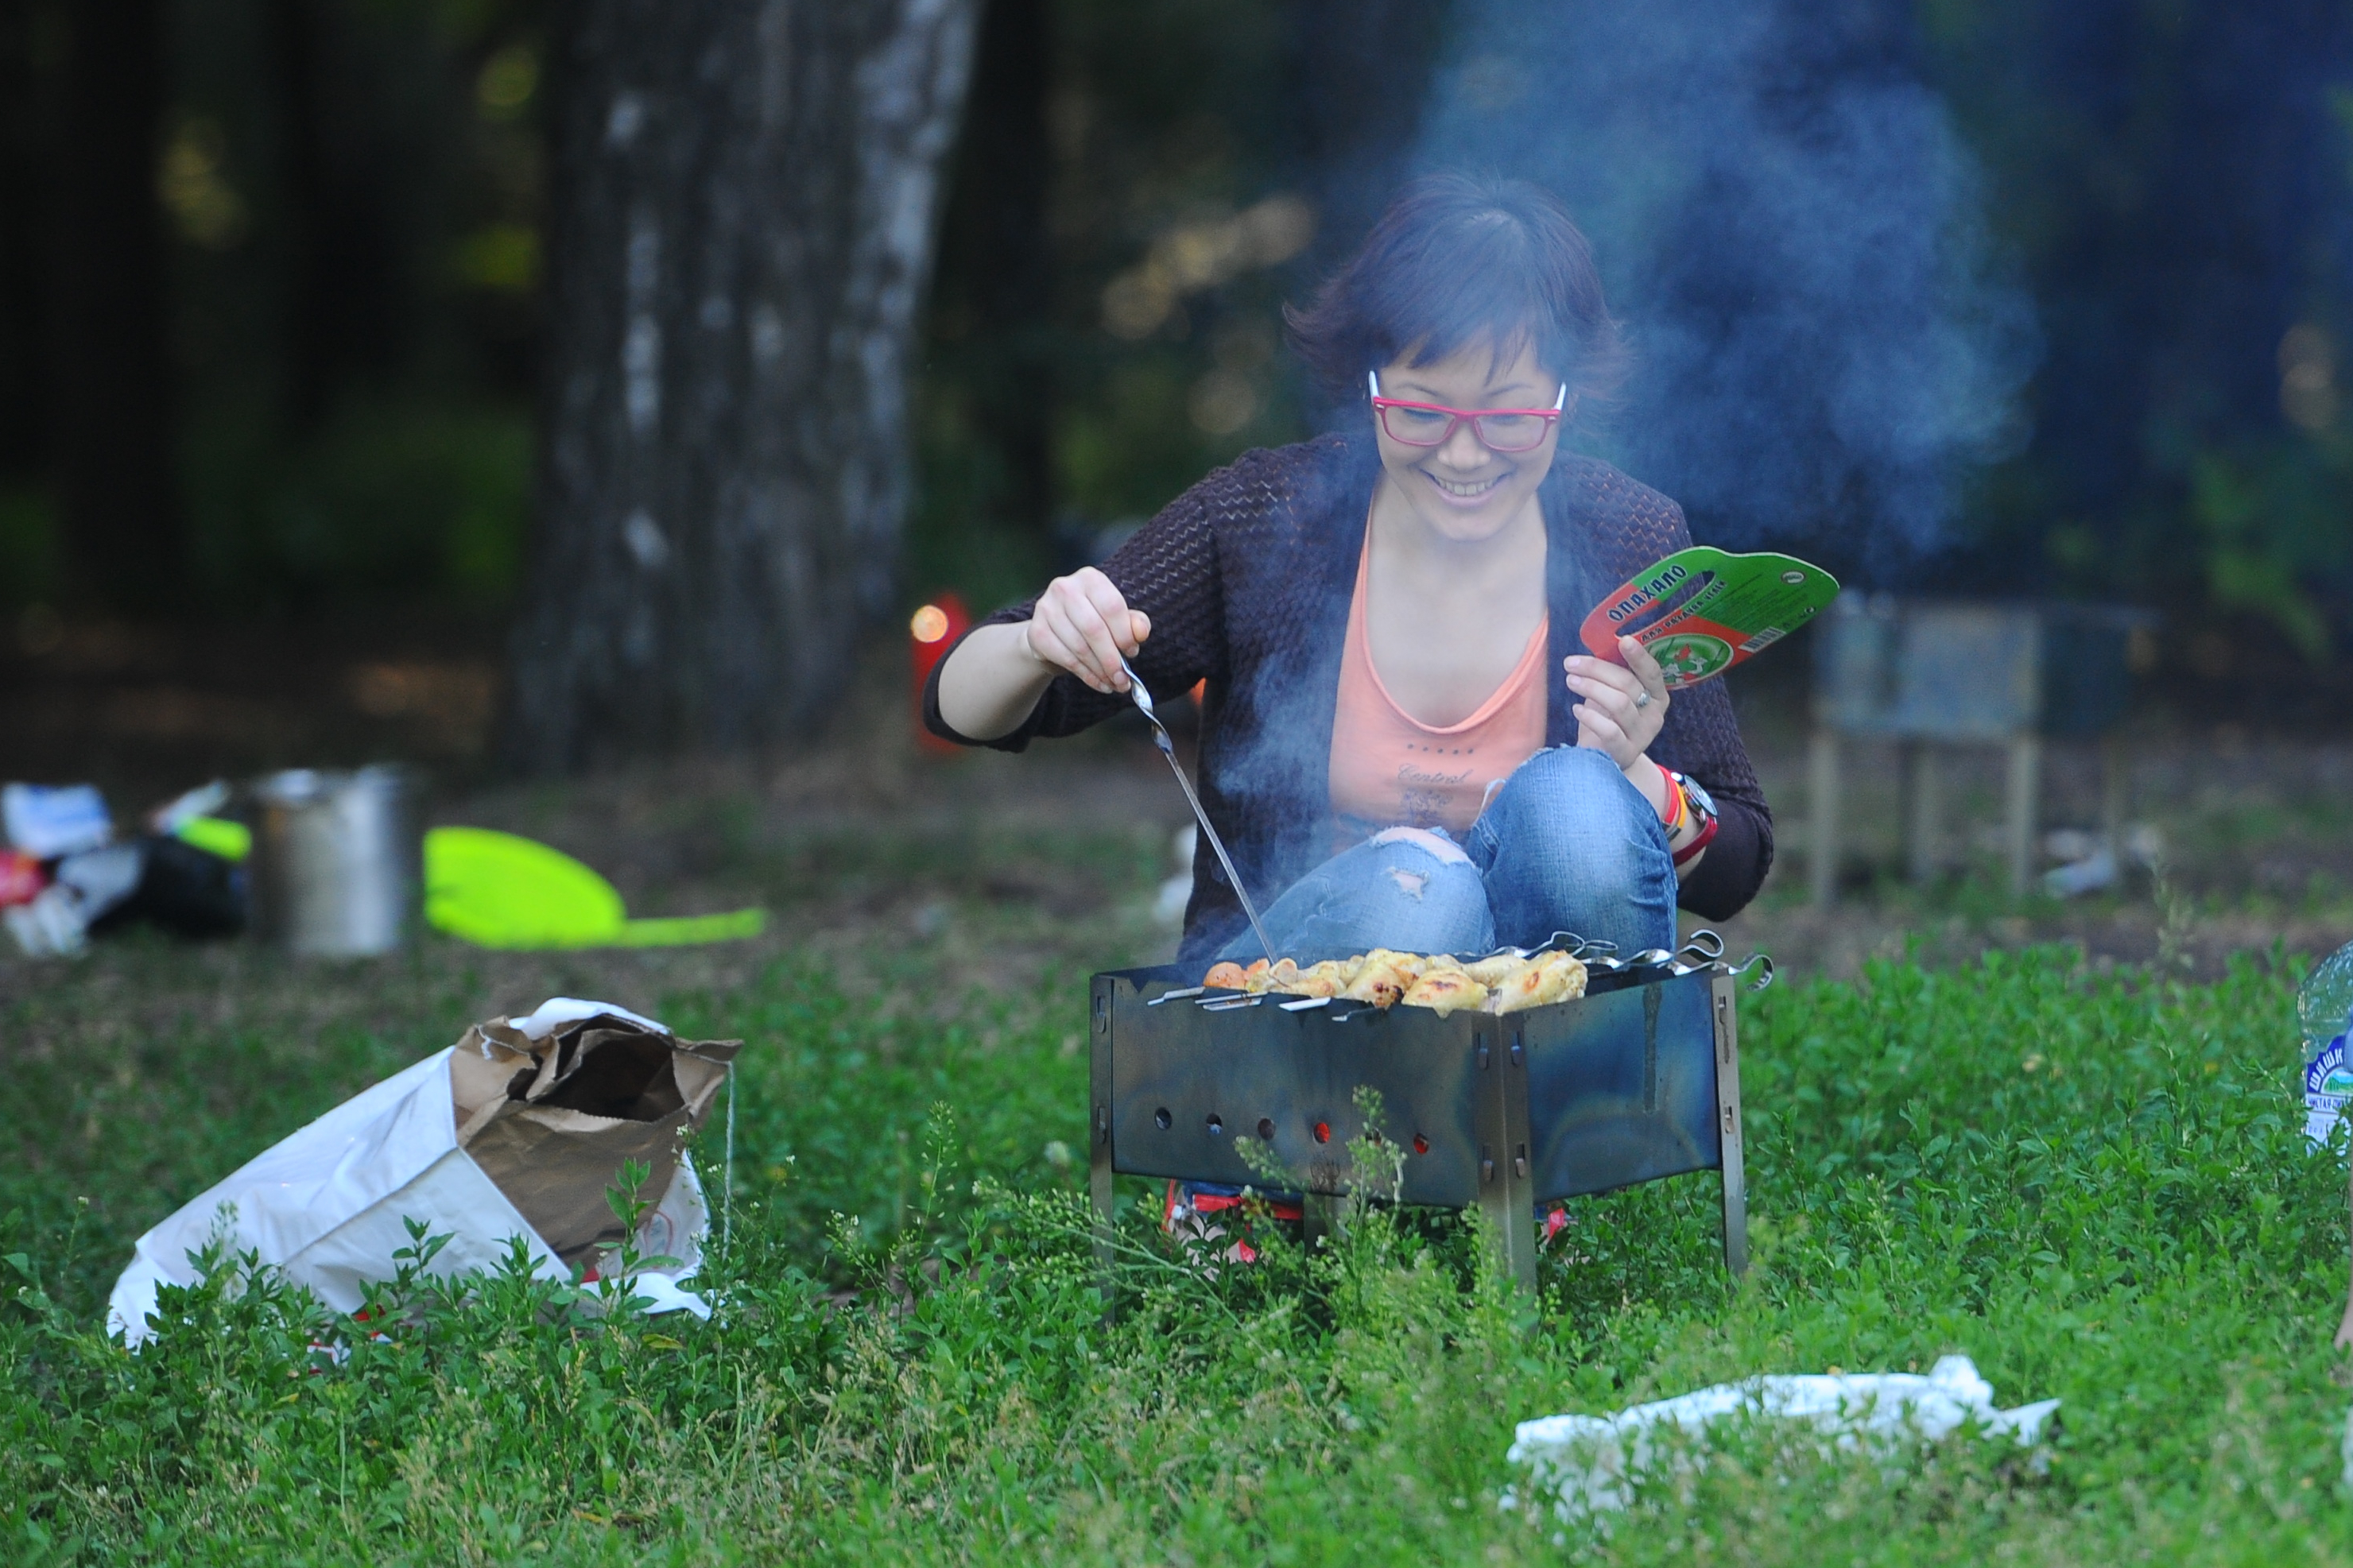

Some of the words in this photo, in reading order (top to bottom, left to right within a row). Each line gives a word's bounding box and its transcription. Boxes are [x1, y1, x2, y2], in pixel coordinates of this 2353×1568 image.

[1607, 564, 1688, 622] ОПАХАЛО
[1642, 627, 1663, 642] ДЛЯ
[1398, 763, 1473, 784] Central
[2309, 1047, 2343, 1091] ШИШК
